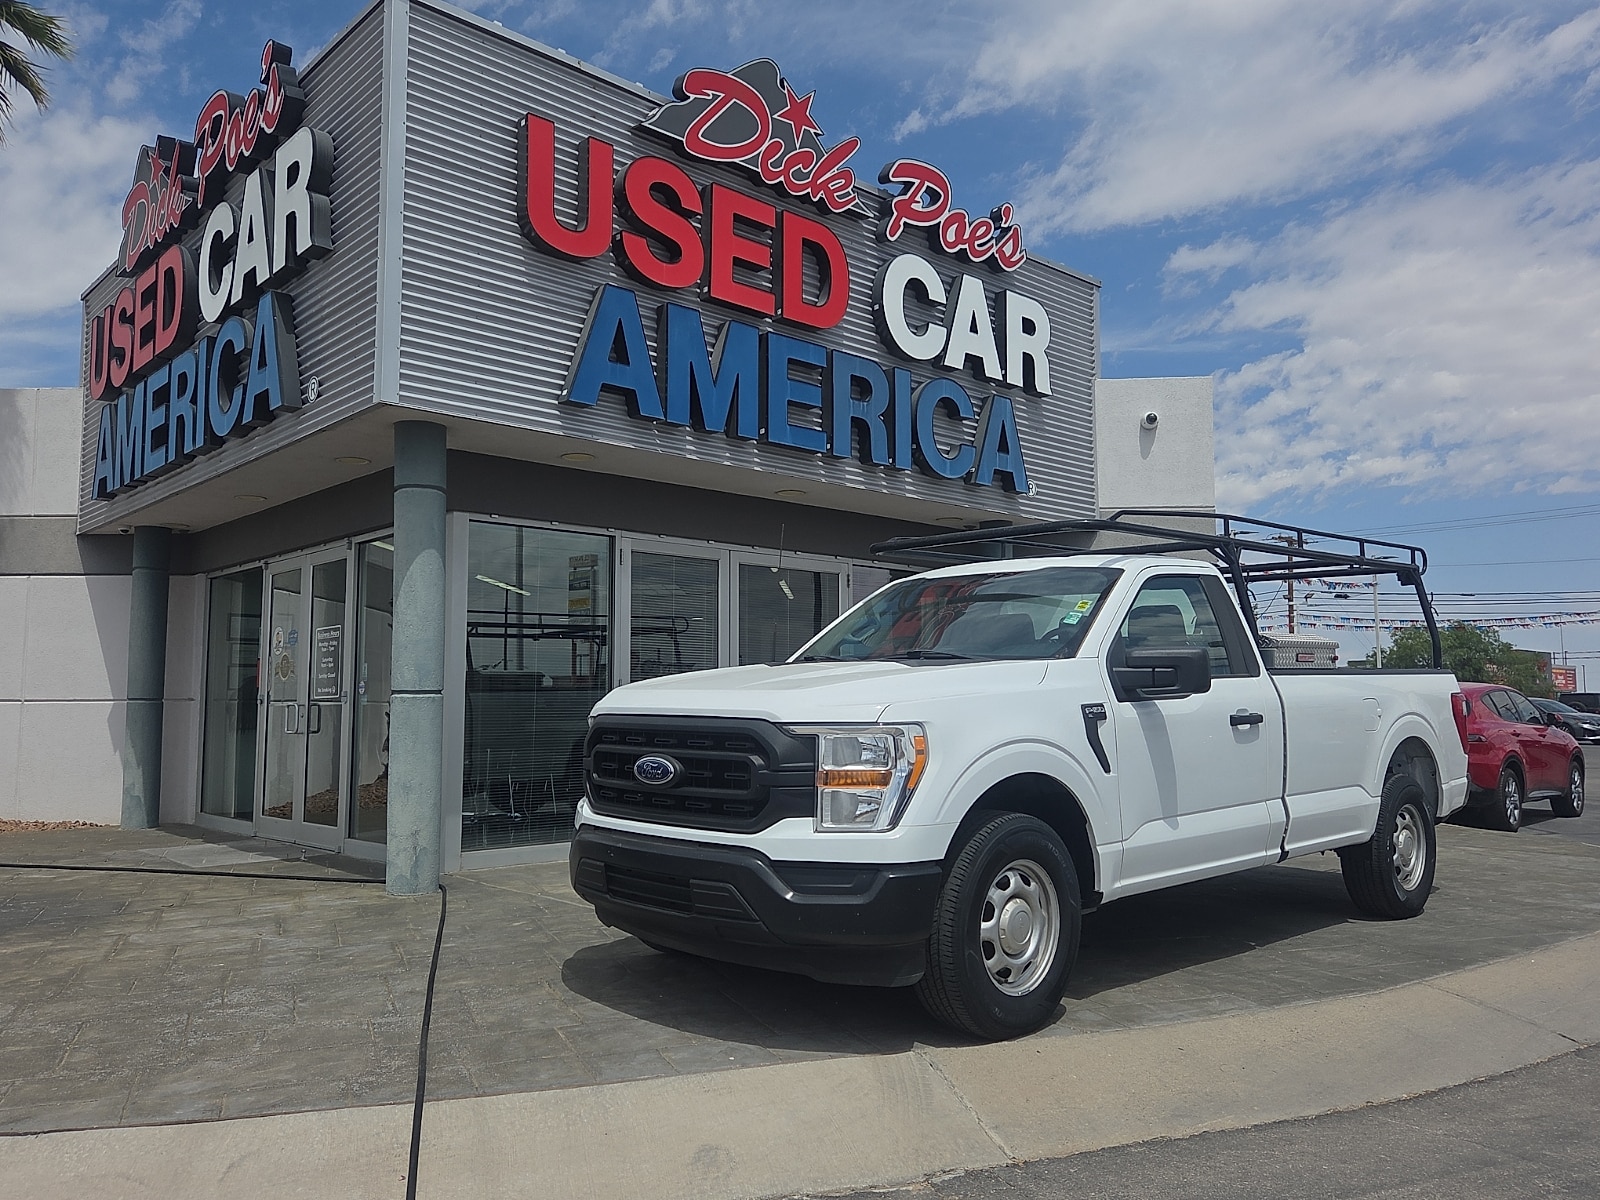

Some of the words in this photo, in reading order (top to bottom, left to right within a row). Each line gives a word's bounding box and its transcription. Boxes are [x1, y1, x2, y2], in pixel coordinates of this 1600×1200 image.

[121, 142, 189, 272] Dick
[194, 39, 286, 209] Poe's
[525, 112, 850, 330] USED
[881, 253, 1053, 396] CAR
[682, 67, 861, 213] Dick
[886, 159, 1028, 273] Poe's
[90, 244, 186, 400] USED
[199, 126, 315, 323] CAR
[92, 290, 282, 500] AMERICA
[567, 283, 1029, 495] AMERICA
[641, 762, 664, 779] Ford
